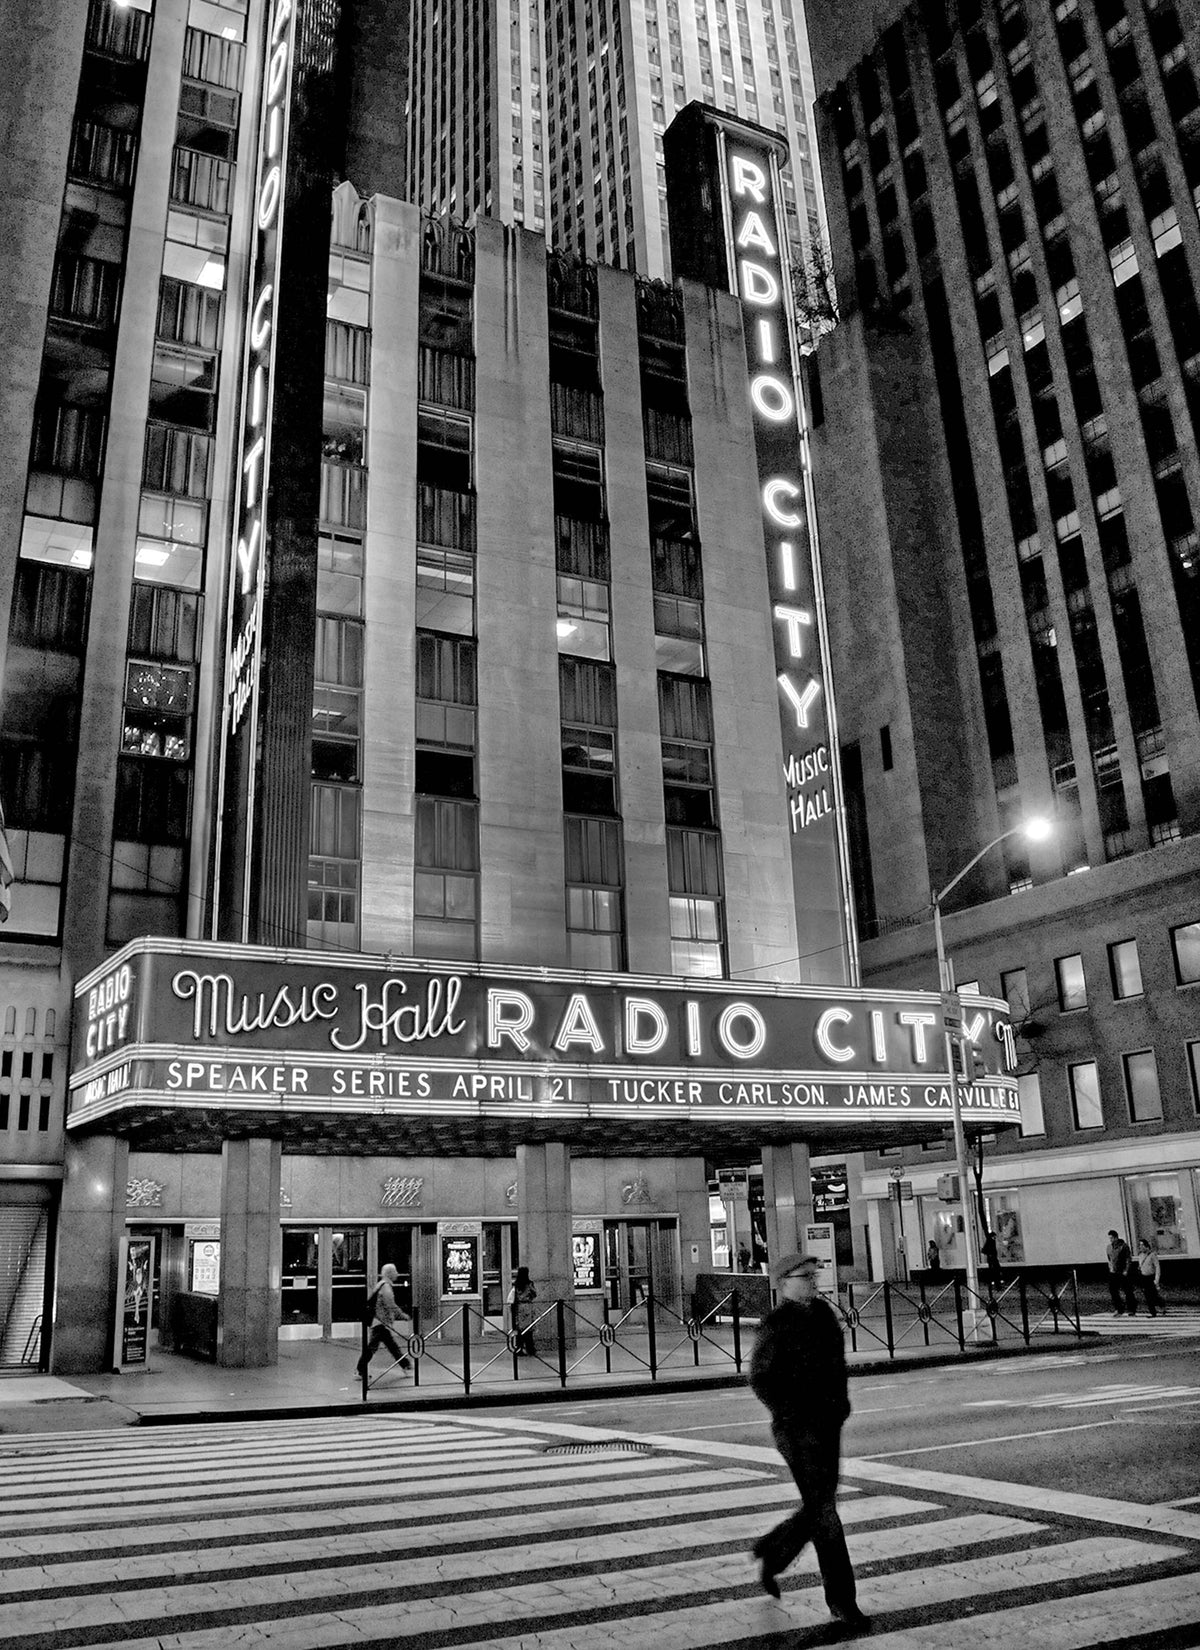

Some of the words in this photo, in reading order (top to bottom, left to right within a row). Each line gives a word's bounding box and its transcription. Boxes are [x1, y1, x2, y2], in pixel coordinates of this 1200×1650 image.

[238, 283, 273, 595] CITY
[732, 155, 793, 421] RADIO
[763, 478, 821, 729] CITY
[789, 788, 833, 834] HALL
[88, 963, 131, 1021] RADIO
[172, 969, 339, 1040] Music
[330, 975, 467, 1051] Hall
[487, 987, 767, 1059] RADIO
[816, 1006, 985, 1064] CITY
[86, 1003, 129, 1057] CITY
[166, 1062, 309, 1093] SPEAKER
[331, 1069, 432, 1098] SERIES
[452, 1074, 532, 1101] APRIL
[551, 1078, 573, 1101] 21
[608, 1079, 703, 1104] TUCKER
[843, 1085, 912, 1107] JAMES
